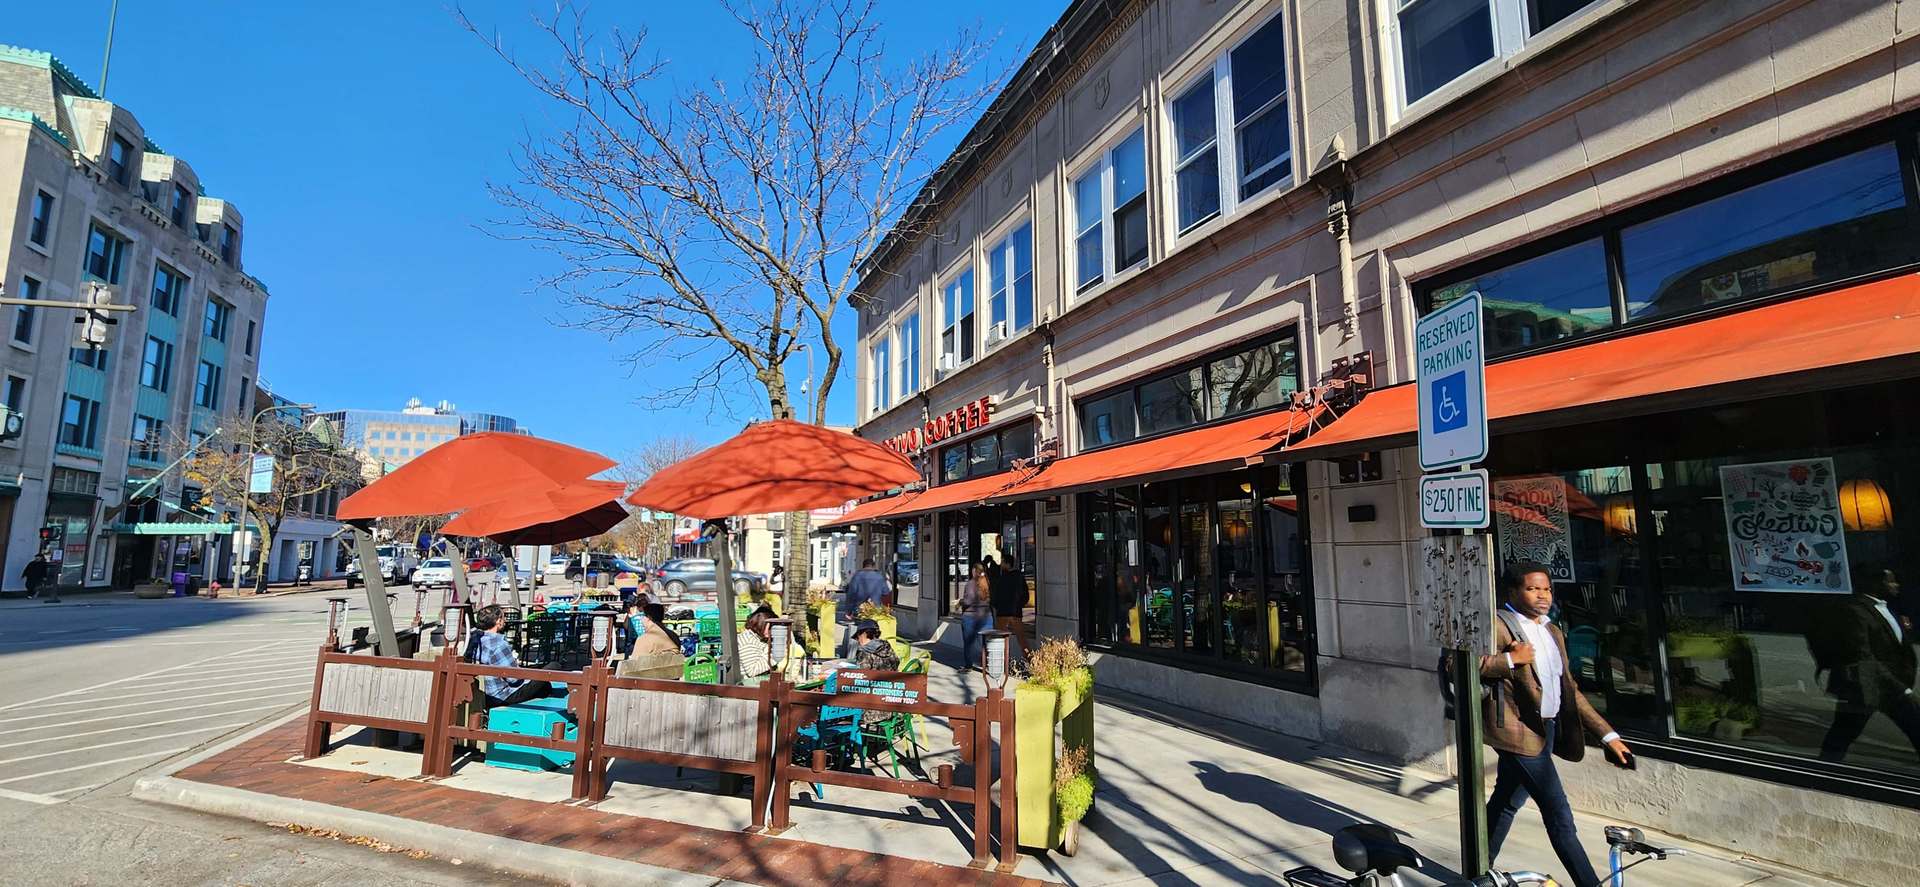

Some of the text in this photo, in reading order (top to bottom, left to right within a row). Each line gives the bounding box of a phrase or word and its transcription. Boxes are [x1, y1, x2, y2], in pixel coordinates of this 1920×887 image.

[1419, 311, 1475, 353] RESERVED
[1423, 340, 1472, 376] PARKING
[924, 396, 990, 446] COFFEE
[1425, 486, 1482, 513] $250 FINE
[841, 686, 870, 694] COLECTIVO
[872, 688, 903, 697] CUSTOMERS
[894, 682, 905, 690] FOR
